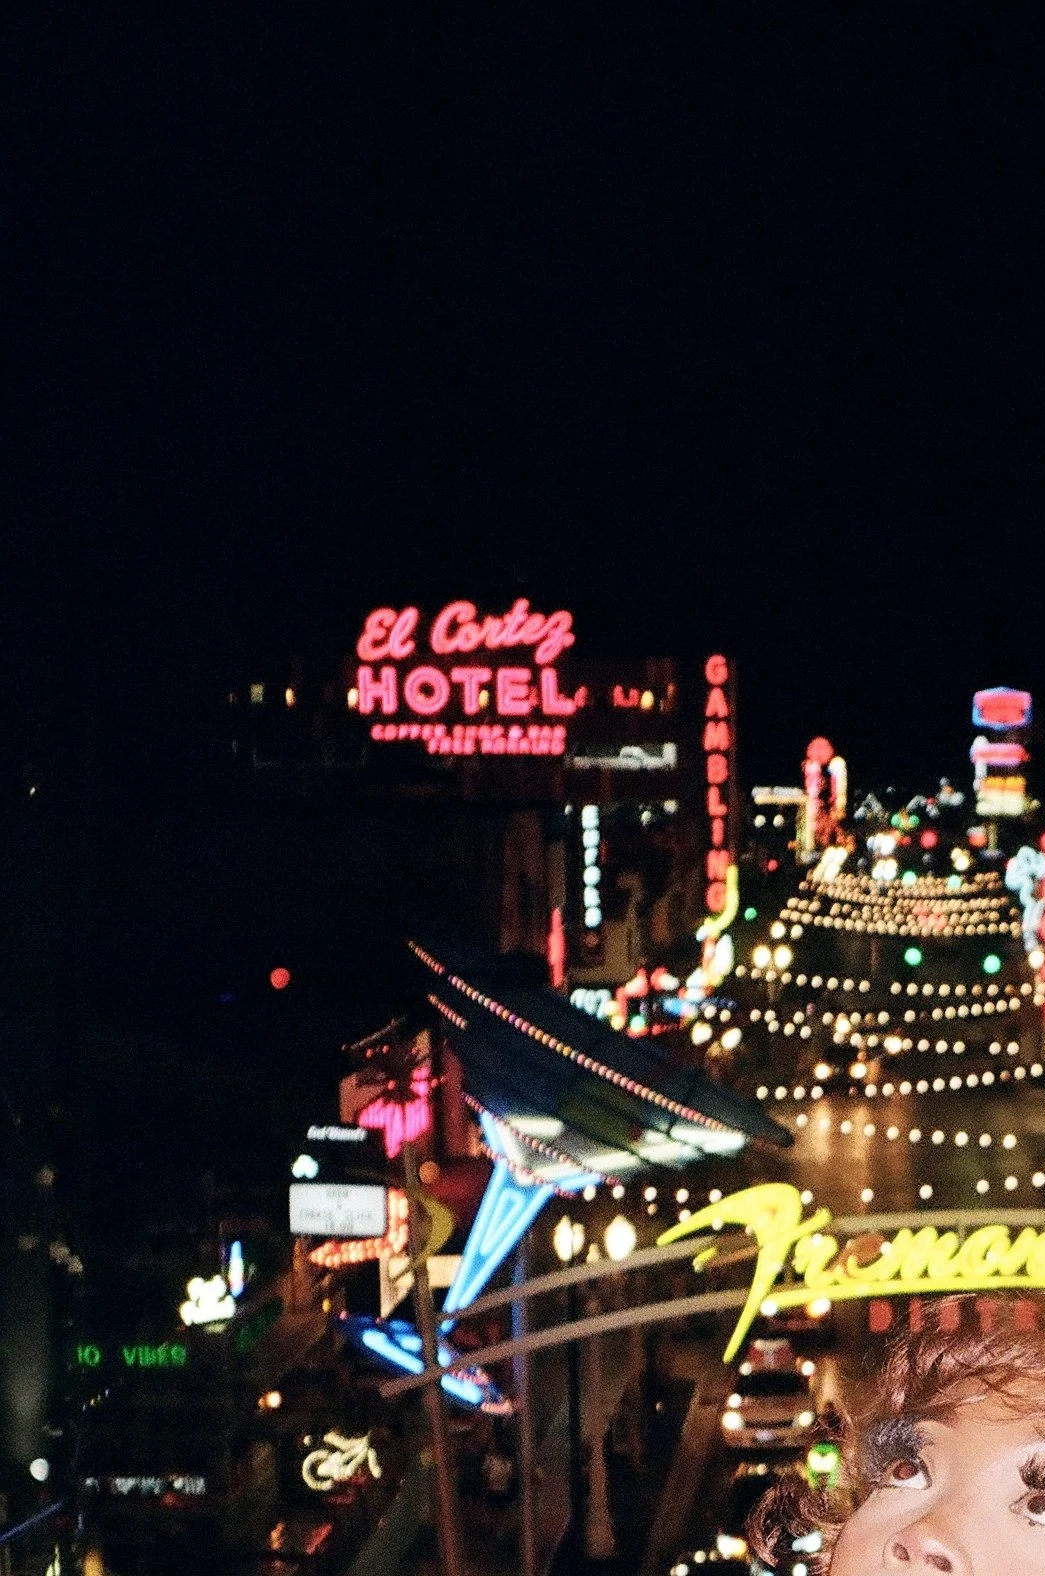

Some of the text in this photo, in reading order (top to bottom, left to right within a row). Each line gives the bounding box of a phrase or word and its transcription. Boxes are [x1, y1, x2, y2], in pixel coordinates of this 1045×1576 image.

[355, 598, 576, 665] El Cortez
[356, 665, 578, 715] HOTEL
[703, 653, 731, 913] GAMBLING
